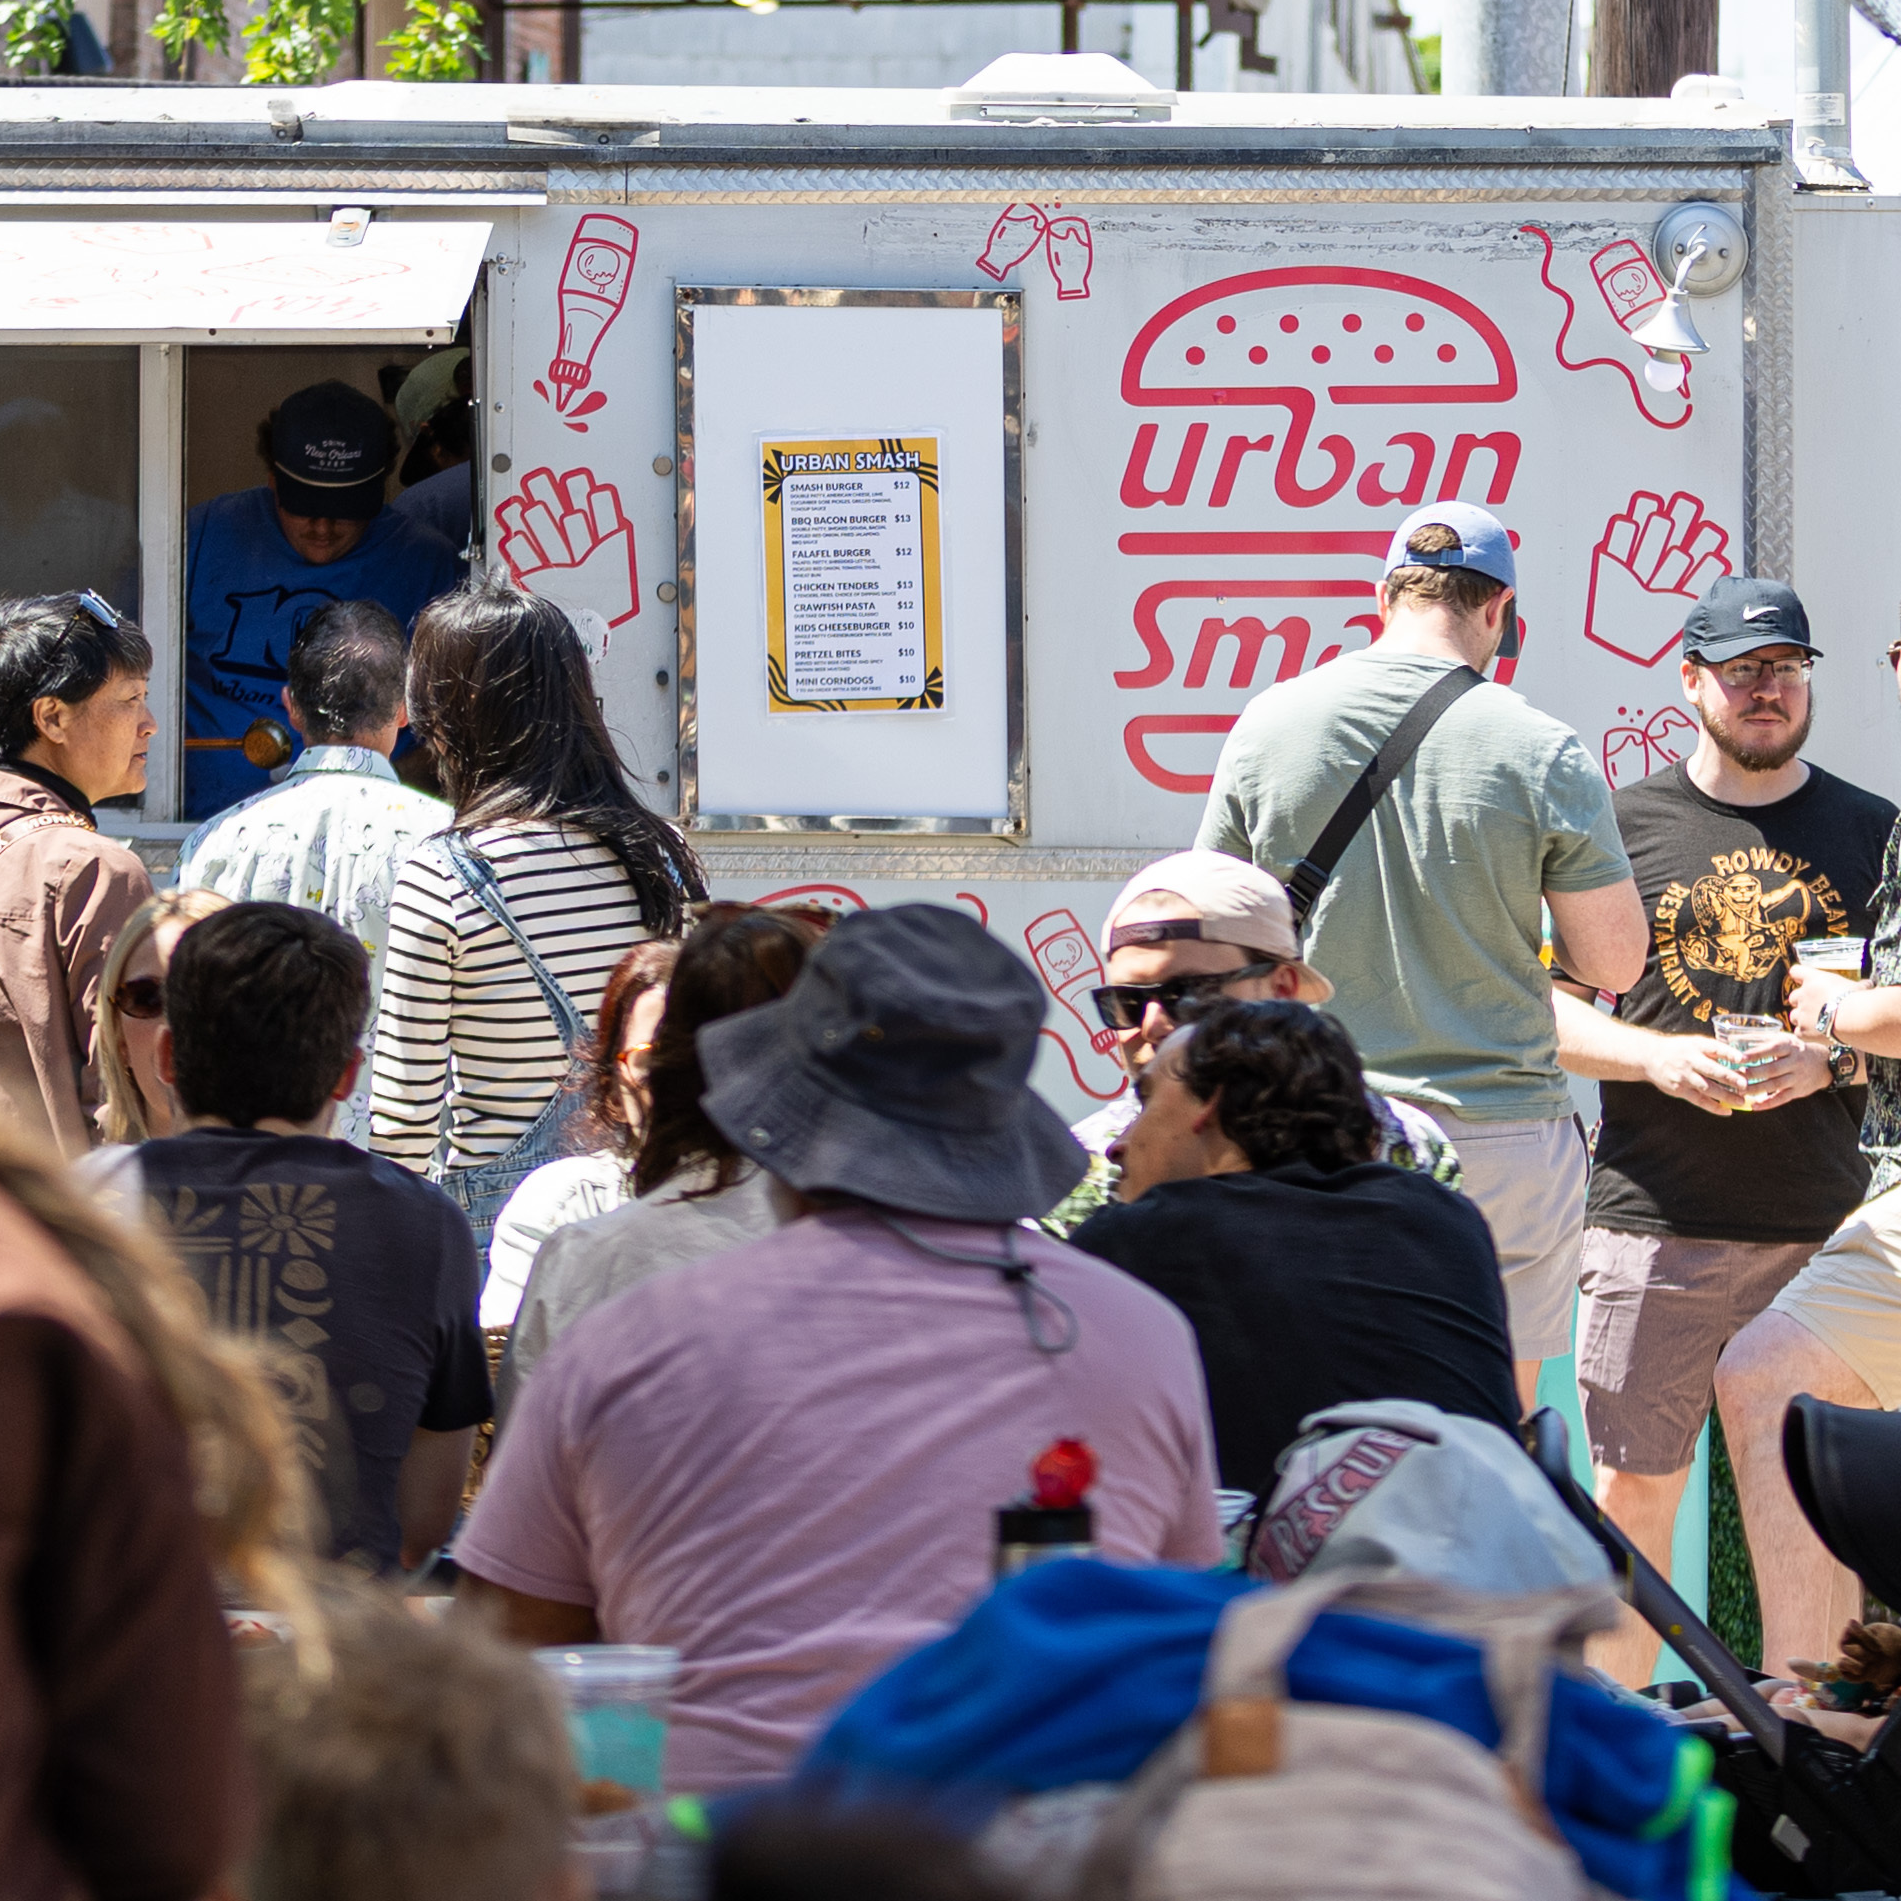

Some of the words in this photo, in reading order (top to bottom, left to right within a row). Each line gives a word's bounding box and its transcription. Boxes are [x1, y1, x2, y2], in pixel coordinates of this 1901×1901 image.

[781, 453, 849, 471] URBAN
[856, 452, 920, 469] SMASH
[1118, 414, 1522, 509] urban
[791, 483, 823, 492] SMASH
[826, 482, 863, 491] BURGER
[894, 481, 910, 490] $12
[792, 517, 811, 525] BBQ
[814, 516, 847, 525] BACON
[849, 515, 887, 524] BURGER
[895, 515, 911, 523] $13
[792, 550, 831, 558] FALAFEL
[833, 549, 871, 557] BURGER
[896, 548, 912, 556] $12
[793, 583, 834, 591] CHICKEN
[837, 582, 879, 590] TENDERS
[897, 581, 913, 589] $13
[794, 603, 843, 612] CRAWFISH
[845, 602, 875, 610] PASTA
[897, 601, 914, 610] $12
[794, 624, 816, 632] KIDS
[818, 622, 890, 632] CHEESEBURGER
[898, 622, 914, 630] $10
[794, 650, 834, 659] PRETZEL
[836, 649, 861, 658] BITES
[898, 649, 915, 657] $10
[796, 678, 818, 686] MINI
[820, 676, 874, 685] CORNDOGS
[899, 675, 916, 684] $10
[1711, 847, 1811, 877] ROWDY
[1808, 873, 1850, 938] BEAV
[1654, 881, 1700, 1005] RESTAURANT
